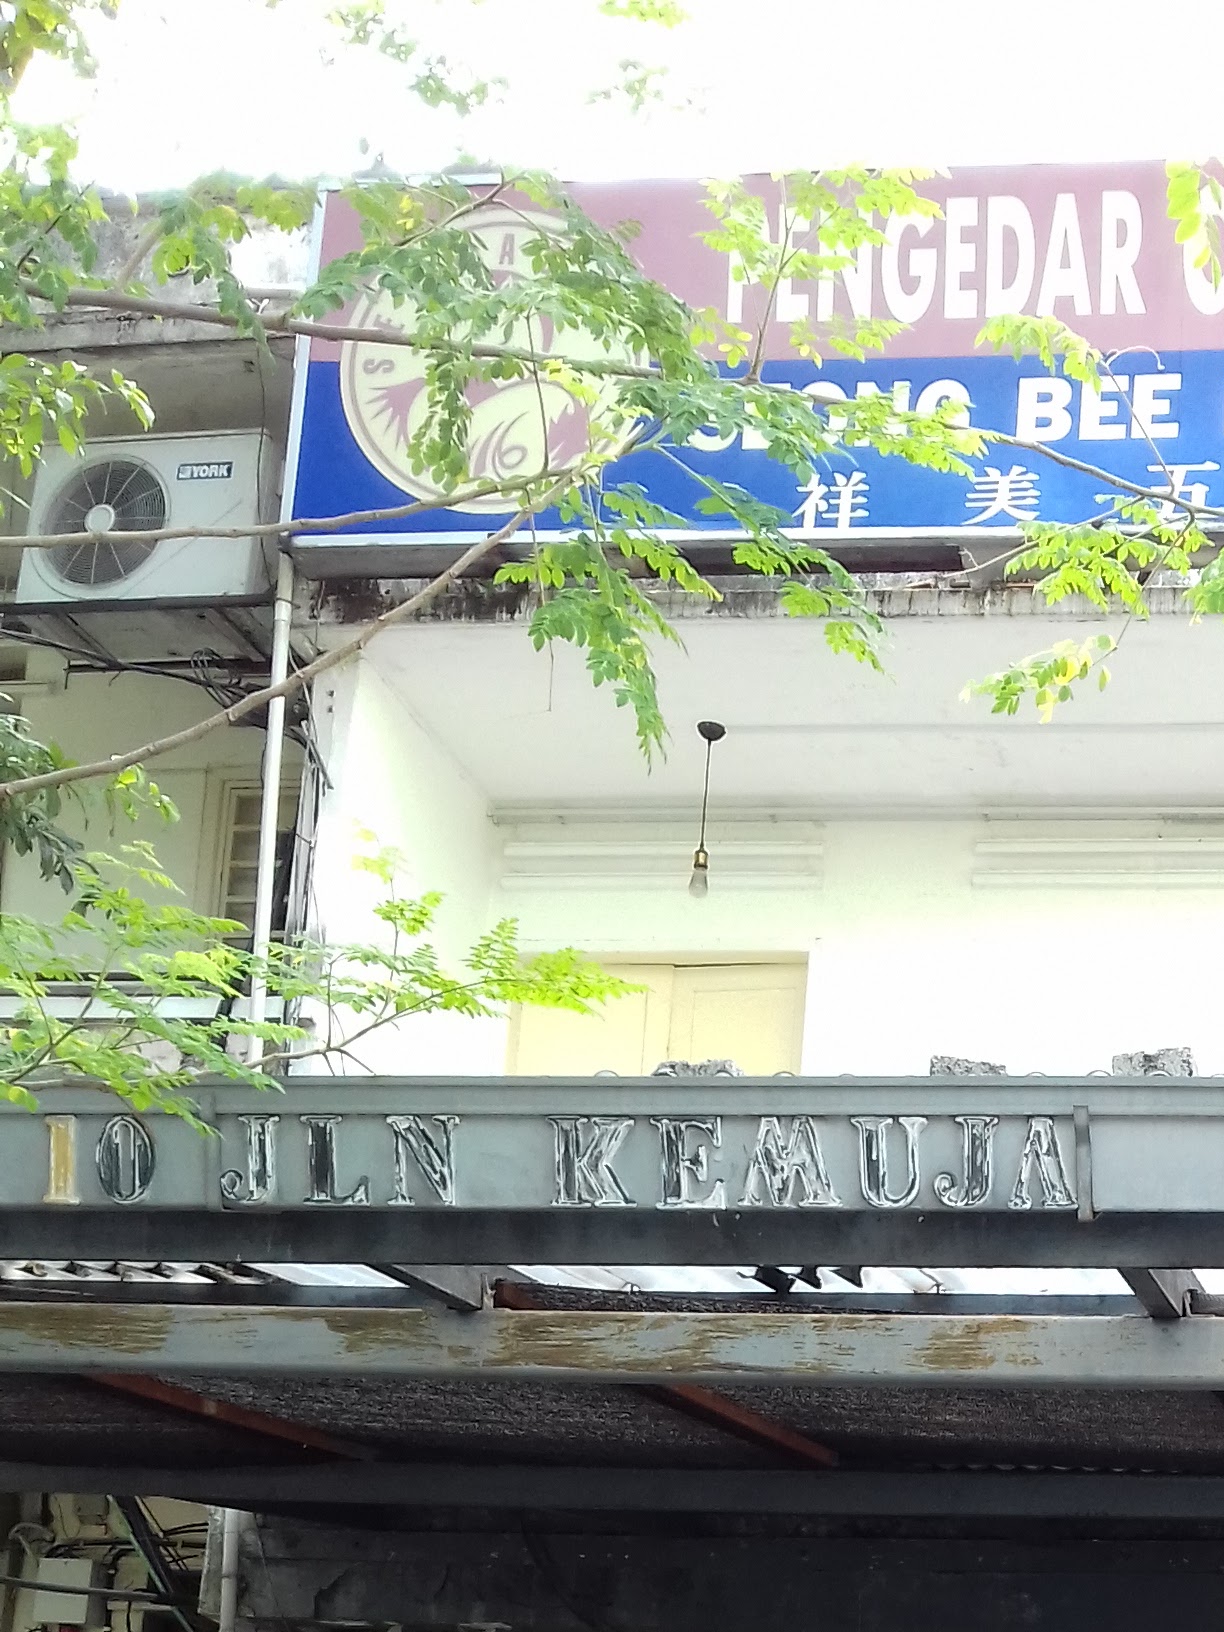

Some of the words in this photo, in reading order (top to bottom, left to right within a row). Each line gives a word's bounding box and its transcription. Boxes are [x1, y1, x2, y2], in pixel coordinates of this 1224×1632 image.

[726, 188, 1145, 323] PENGEDAR
[1015, 372, 1182, 442] BEE
[190, 463, 230, 478] YORK
[219, 1114, 461, 1206] JLN
[549, 1115, 1080, 1208] KEMUJA
